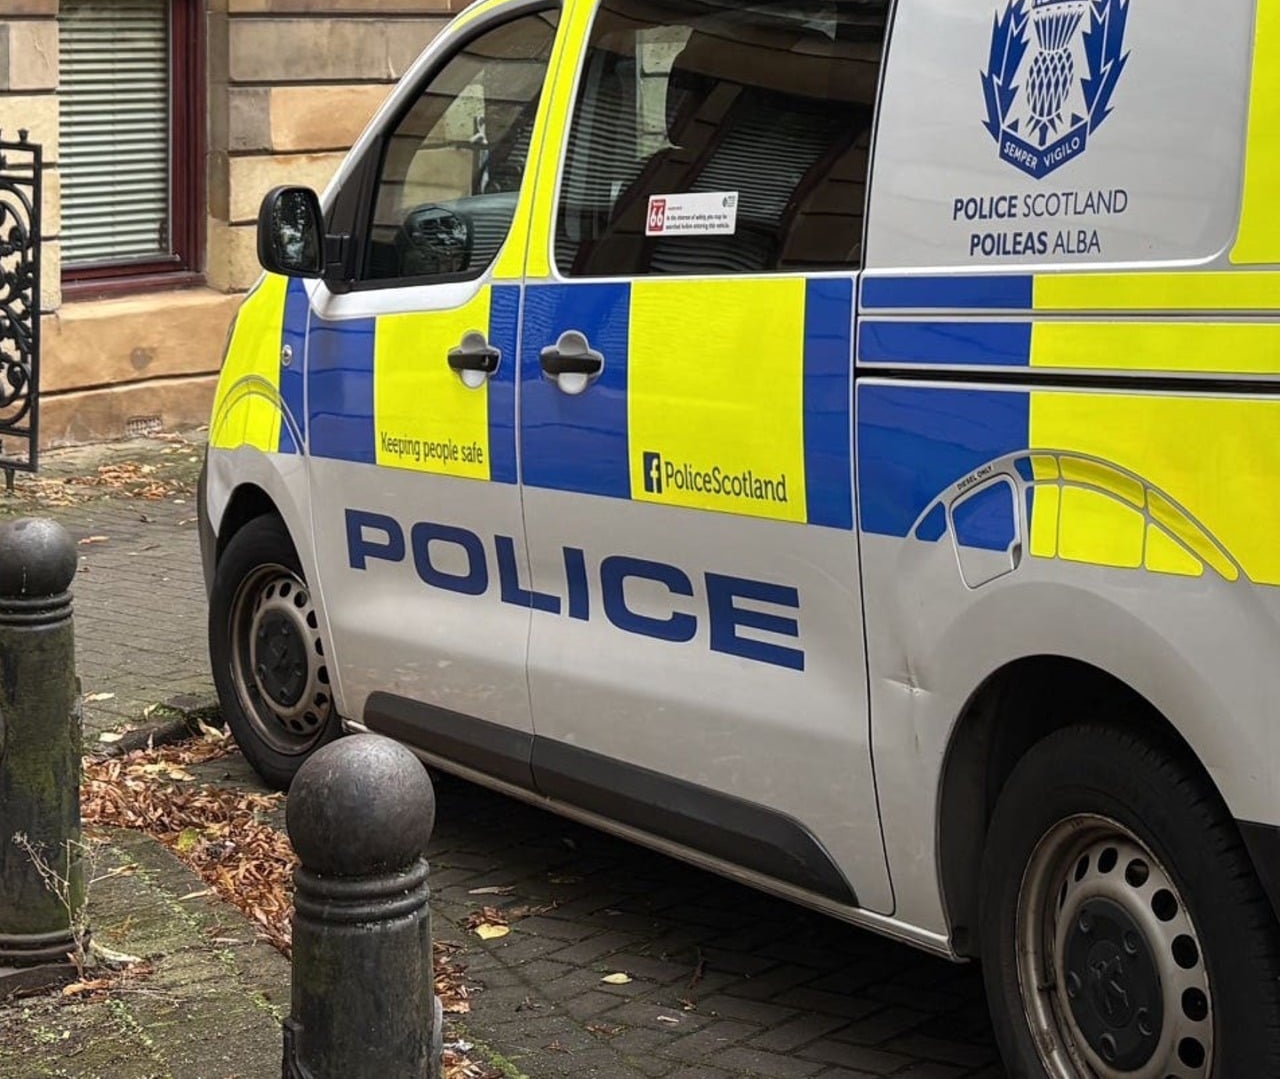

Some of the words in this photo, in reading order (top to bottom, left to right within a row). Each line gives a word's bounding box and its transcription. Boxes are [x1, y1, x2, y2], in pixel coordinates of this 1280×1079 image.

[1003, 141, 1038, 170] SEMPER
[1043, 136, 1080, 167] VIGILO
[953, 195, 1018, 221] POLICE
[1022, 189, 1128, 218] SCOTLAND
[970, 231, 1048, 256] POILEAS
[1052, 230, 1101, 254] ALBA
[380, 431, 420, 462] Keeping
[423, 438, 458, 466] people
[461, 441, 483, 464] safe
[664, 461, 788, 502] PoliceScotland
[344, 508, 804, 672] POLICE
